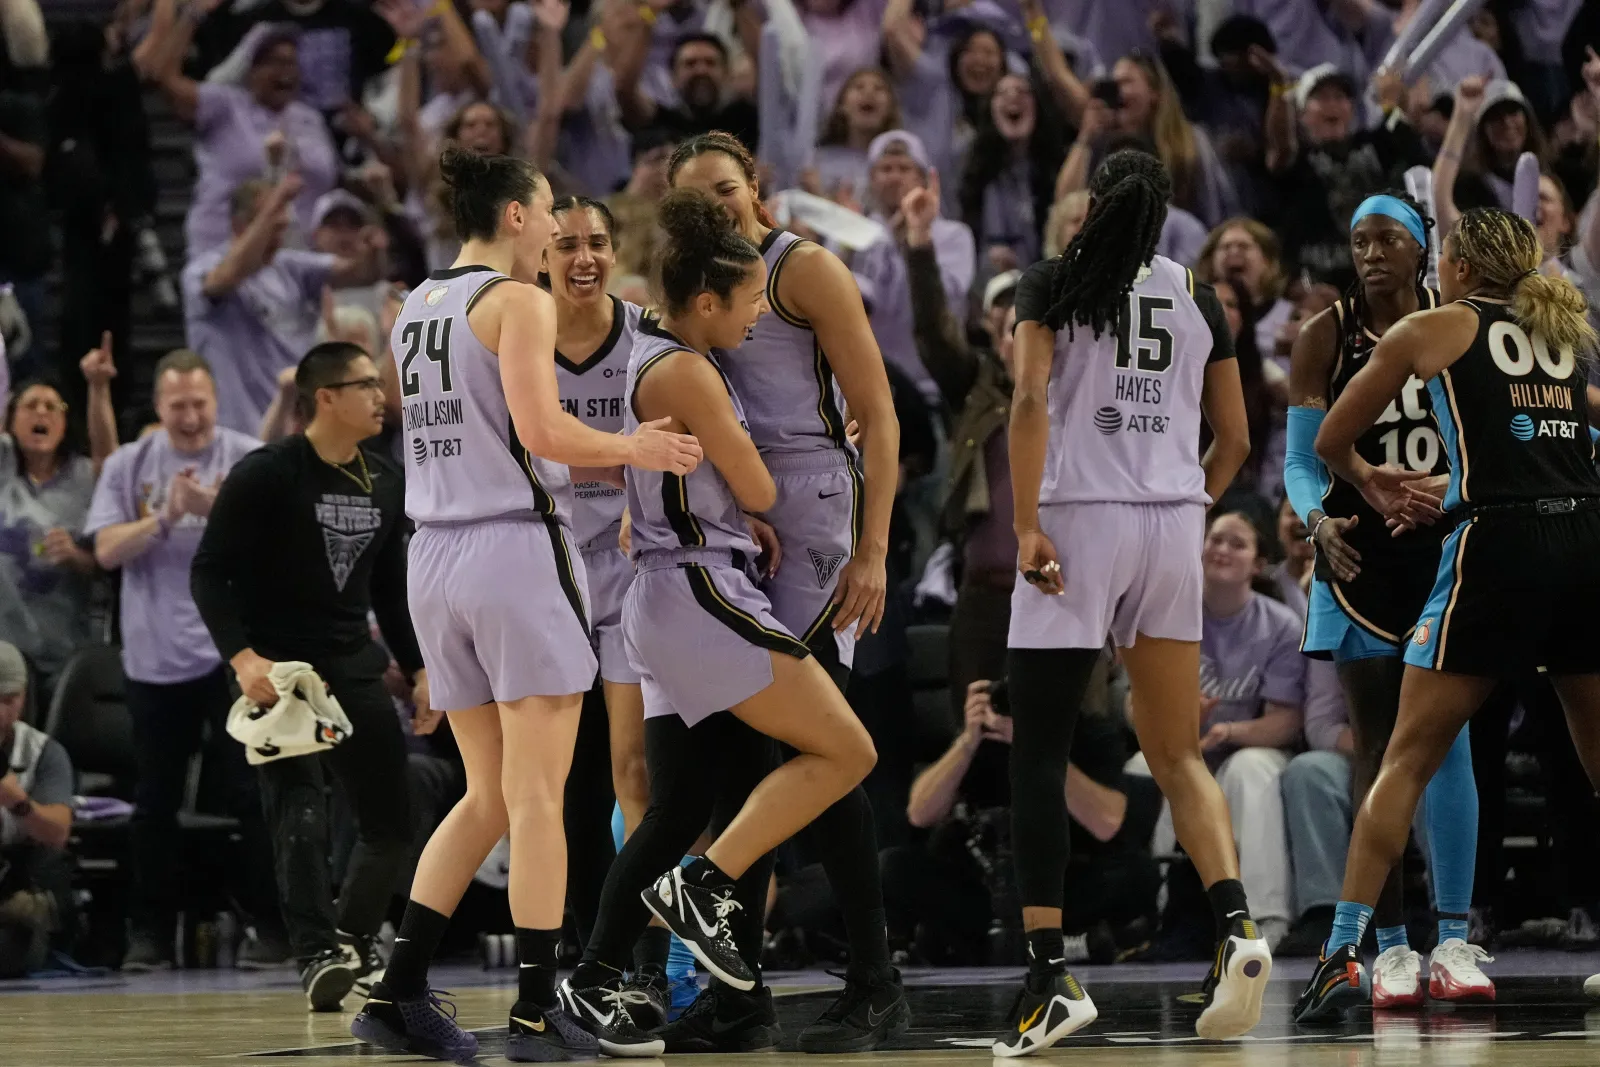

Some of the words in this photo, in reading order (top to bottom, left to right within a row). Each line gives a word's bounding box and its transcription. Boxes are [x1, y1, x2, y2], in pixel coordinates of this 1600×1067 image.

[1114, 293, 1175, 374] 15
[401, 315, 455, 397] 24
[1488, 320, 1575, 380] 00
[1115, 374, 1162, 405] HAYES
[1509, 383, 1573, 411] HILLMON
[402, 398, 464, 432] ZANDALASINI
[1126, 414, 1171, 434] AT&T
[1537, 419, 1579, 440] AT&T
[429, 438, 462, 459] T&T
[1378, 425, 1440, 472] 10
[574, 481, 600, 489] KAISER
[574, 488, 625, 499] PERMANENTE
